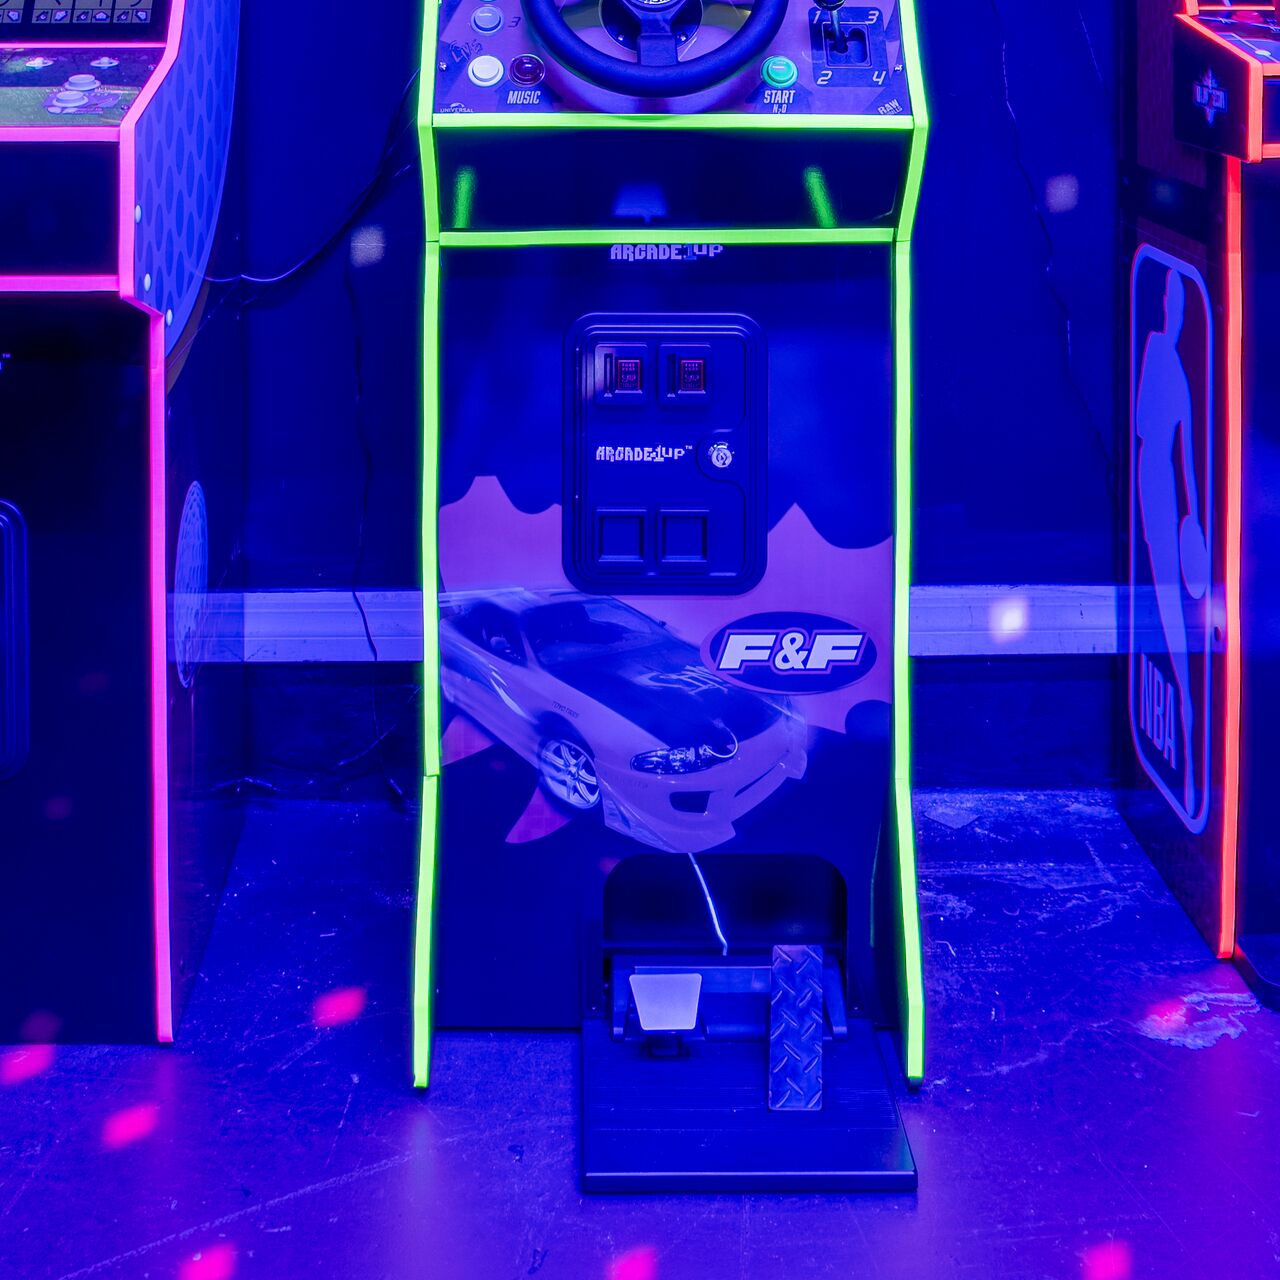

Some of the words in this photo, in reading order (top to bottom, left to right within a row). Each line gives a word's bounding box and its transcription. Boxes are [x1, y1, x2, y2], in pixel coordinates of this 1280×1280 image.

[812, 11, 822, 24] 1
[866, 11, 880, 24] 3
[817, 71, 833, 85] 2
[872, 71, 886, 85] 4
[507, 90, 541, 105] MUSIC
[763, 90, 795, 104] START
[610, 243, 724, 262] ARCADE1UP
[596, 445, 685, 462] ARCADE1UP
[719, 632, 864, 671] F&F
[1139, 652, 1177, 771] NBA
